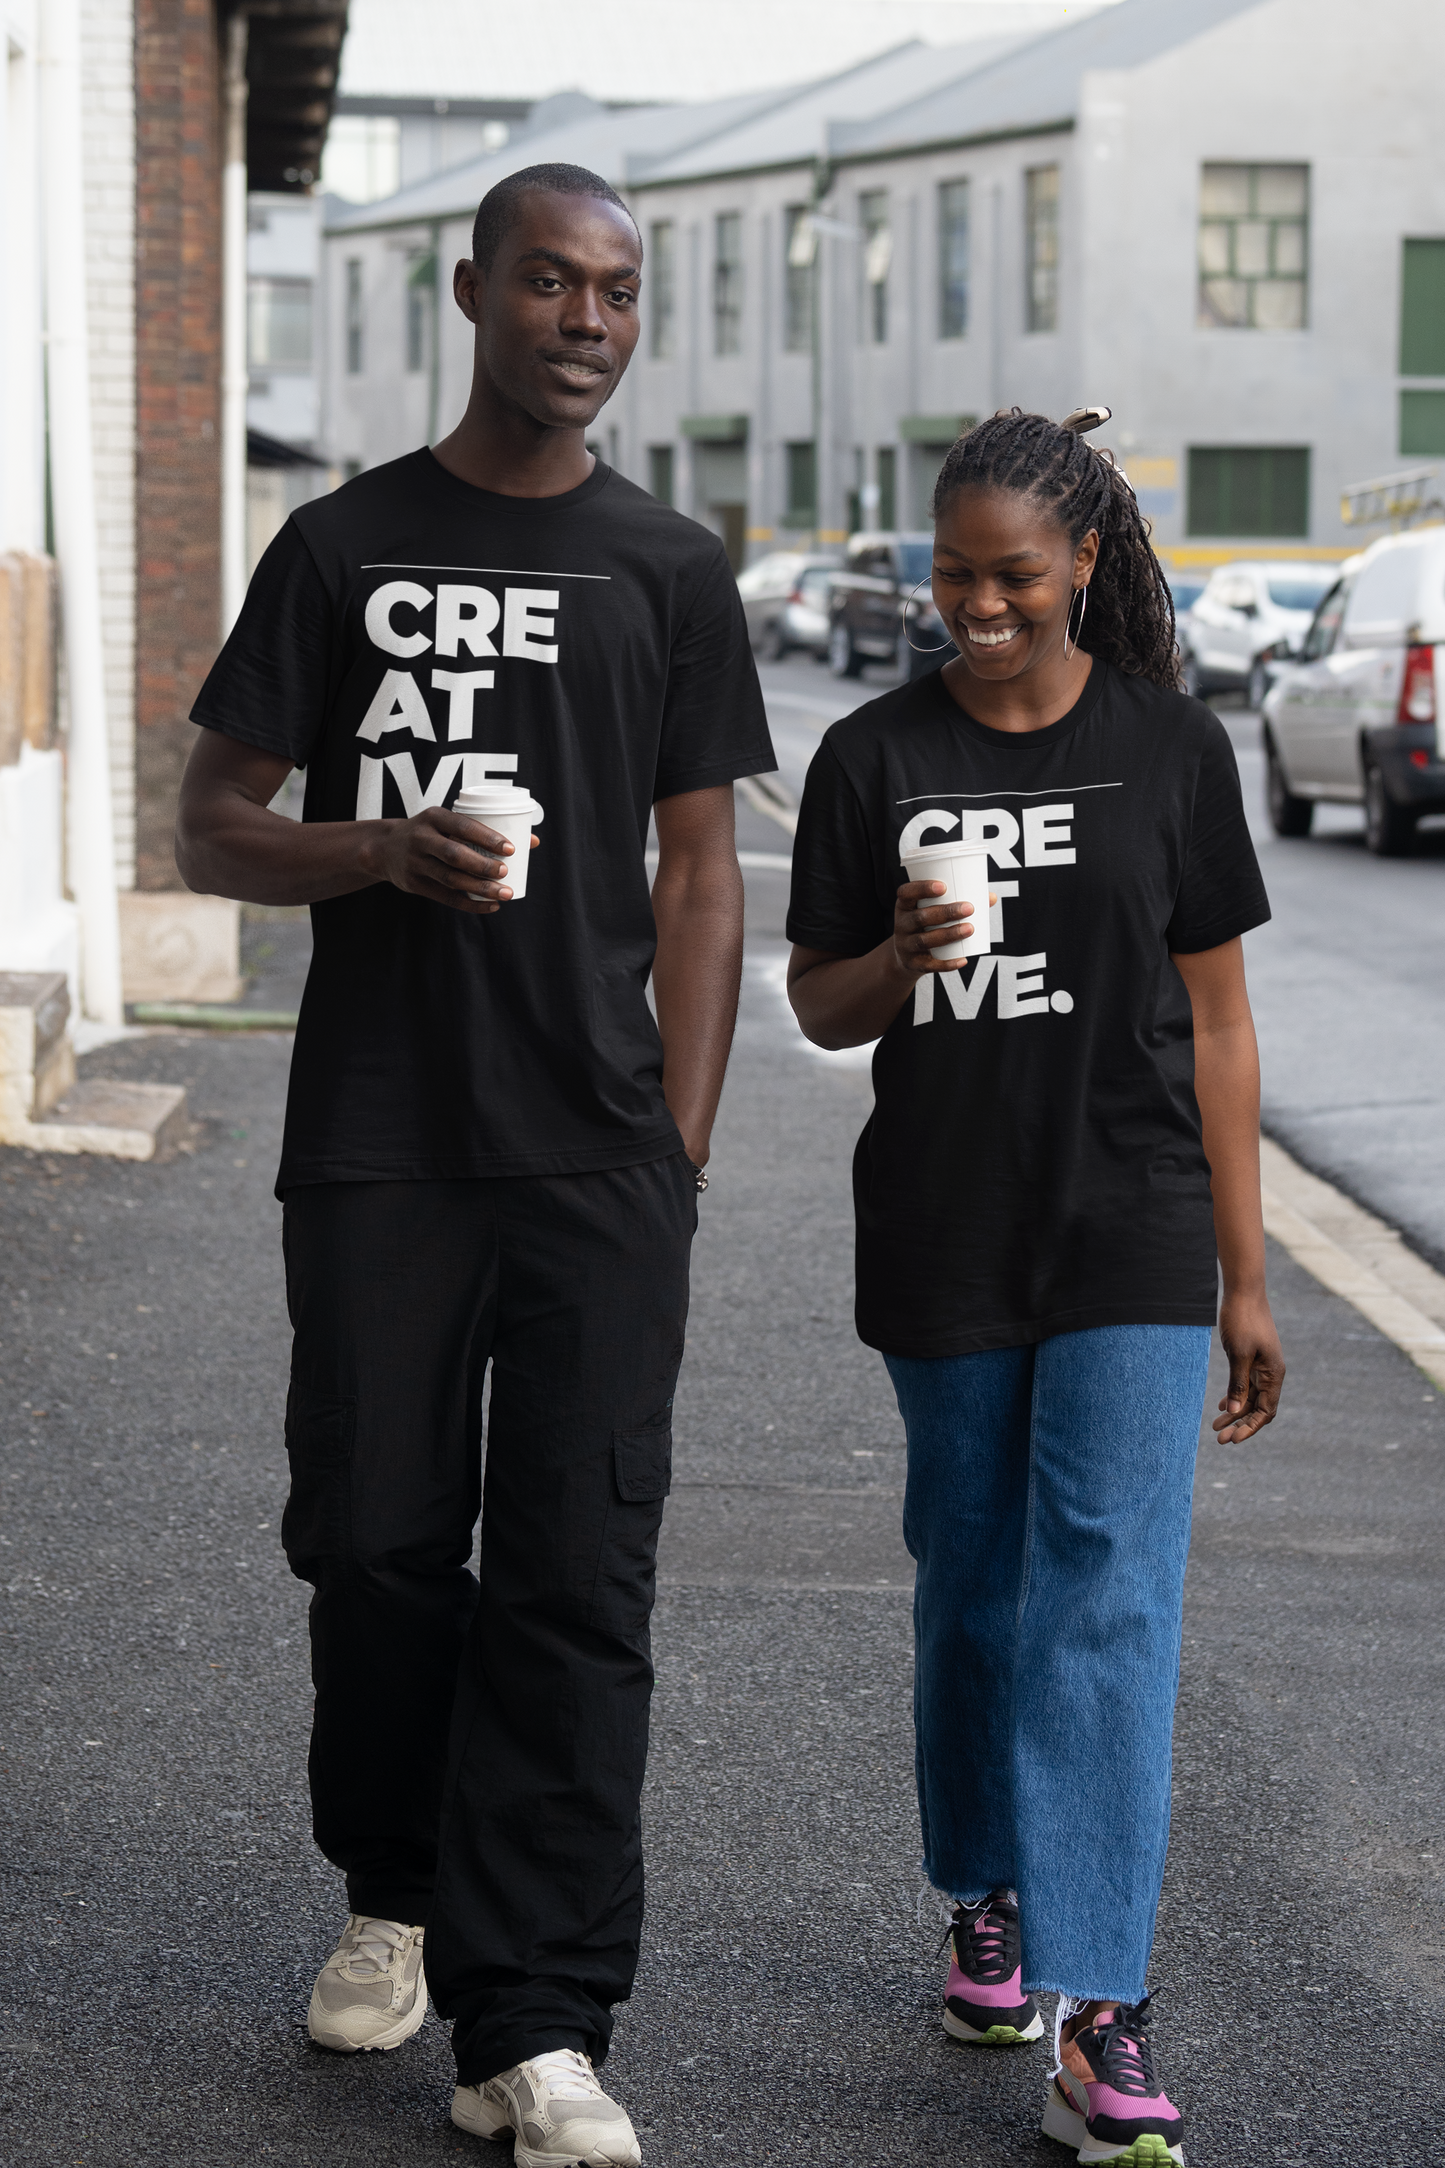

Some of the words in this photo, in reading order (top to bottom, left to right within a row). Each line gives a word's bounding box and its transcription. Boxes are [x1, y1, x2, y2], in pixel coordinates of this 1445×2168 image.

[365, 580, 560, 663] CRE
[355, 668, 495, 743] AT
[913, 952, 1074, 1026] IVE.
